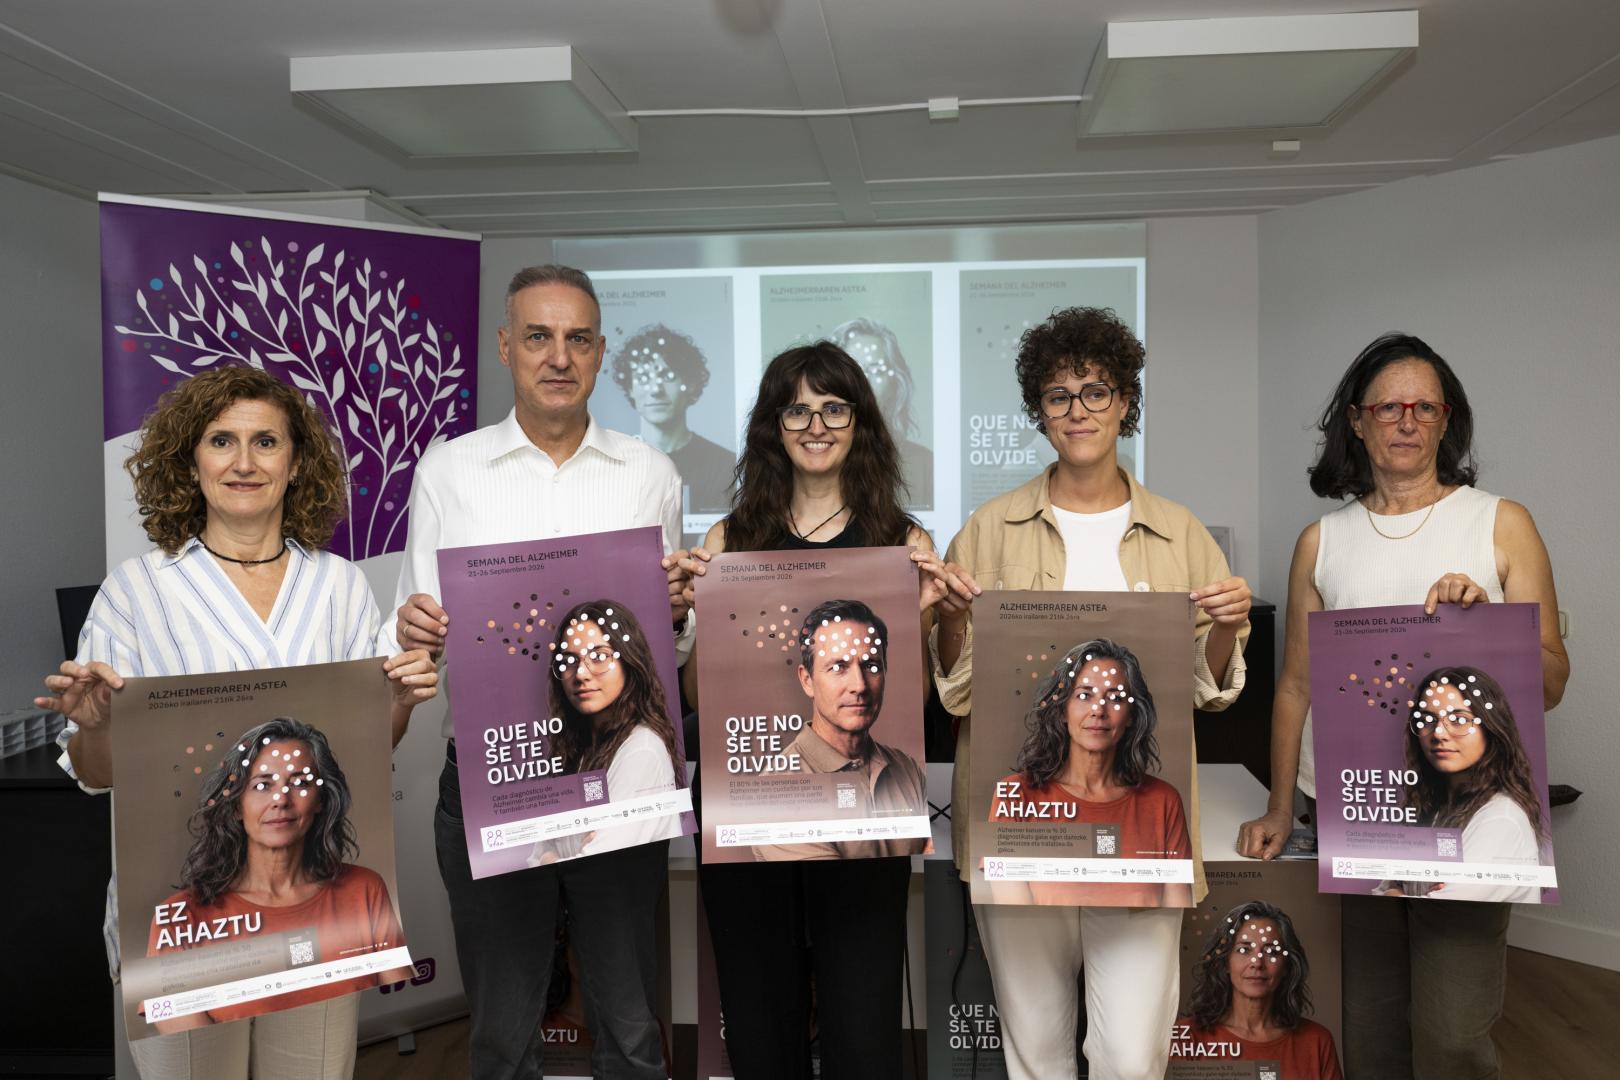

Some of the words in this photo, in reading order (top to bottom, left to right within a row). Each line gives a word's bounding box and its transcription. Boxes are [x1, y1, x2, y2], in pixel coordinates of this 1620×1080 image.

[970, 414, 1008, 433] QUE
[970, 432, 993, 448] SE
[997, 432, 1020, 448] TE
[969, 449, 1037, 465] OLVIDE
[467, 556, 507, 568] SEMANA
[508, 554, 526, 564] DEL
[527, 548, 579, 562] ALZHEIMER
[720, 564, 757, 574] SEMANA
[758, 563, 775, 572] DEL
[777, 561, 827, 572] ALZHEIMER
[777, 572, 793, 581] 2026
[999, 602, 1078, 612] ALZHEIMERRAREN
[1079, 603, 1107, 612] ASTEA
[1334, 618, 1370, 628] SEMANA
[1372, 617, 1388, 626] DEL
[1390, 615, 1441, 625] ALZHEIMER
[148, 683, 251, 701] ALZHEIMERRAREN
[253, 680, 288, 691] ASTEA
[483, 723, 528, 748] QUE
[533, 717, 563, 738] NO
[725, 715, 768, 737] QUE
[773, 714, 803, 732] NO
[485, 745, 512, 765] SE
[517, 740, 543, 759] TE
[726, 735, 752, 754] SE
[756, 735, 782, 752] TE
[487, 756, 564, 785] OLVIDE
[727, 754, 801, 773] OLVIDE
[1341, 769, 1383, 787] QUE
[1389, 770, 1419, 786] NO
[996, 781, 1021, 798] EZ
[1341, 786, 1367, 803] SE
[1371, 787, 1397, 804] TE
[995, 801, 1077, 819] AHAZTU
[1342, 805, 1418, 823] OLVIDE
[155, 901, 188, 925] EZ
[156, 911, 261, 950] AHAZTU
[949, 1004, 984, 1020] QUE
[989, 1004, 1000, 1018] N
[949, 1019, 970, 1033] SE
[974, 1020, 995, 1033] TE
[1170, 1025, 1191, 1039] EZ
[949, 1035, 1001, 1049] OLVID
[1169, 1042, 1241, 1057] AHAZTU
